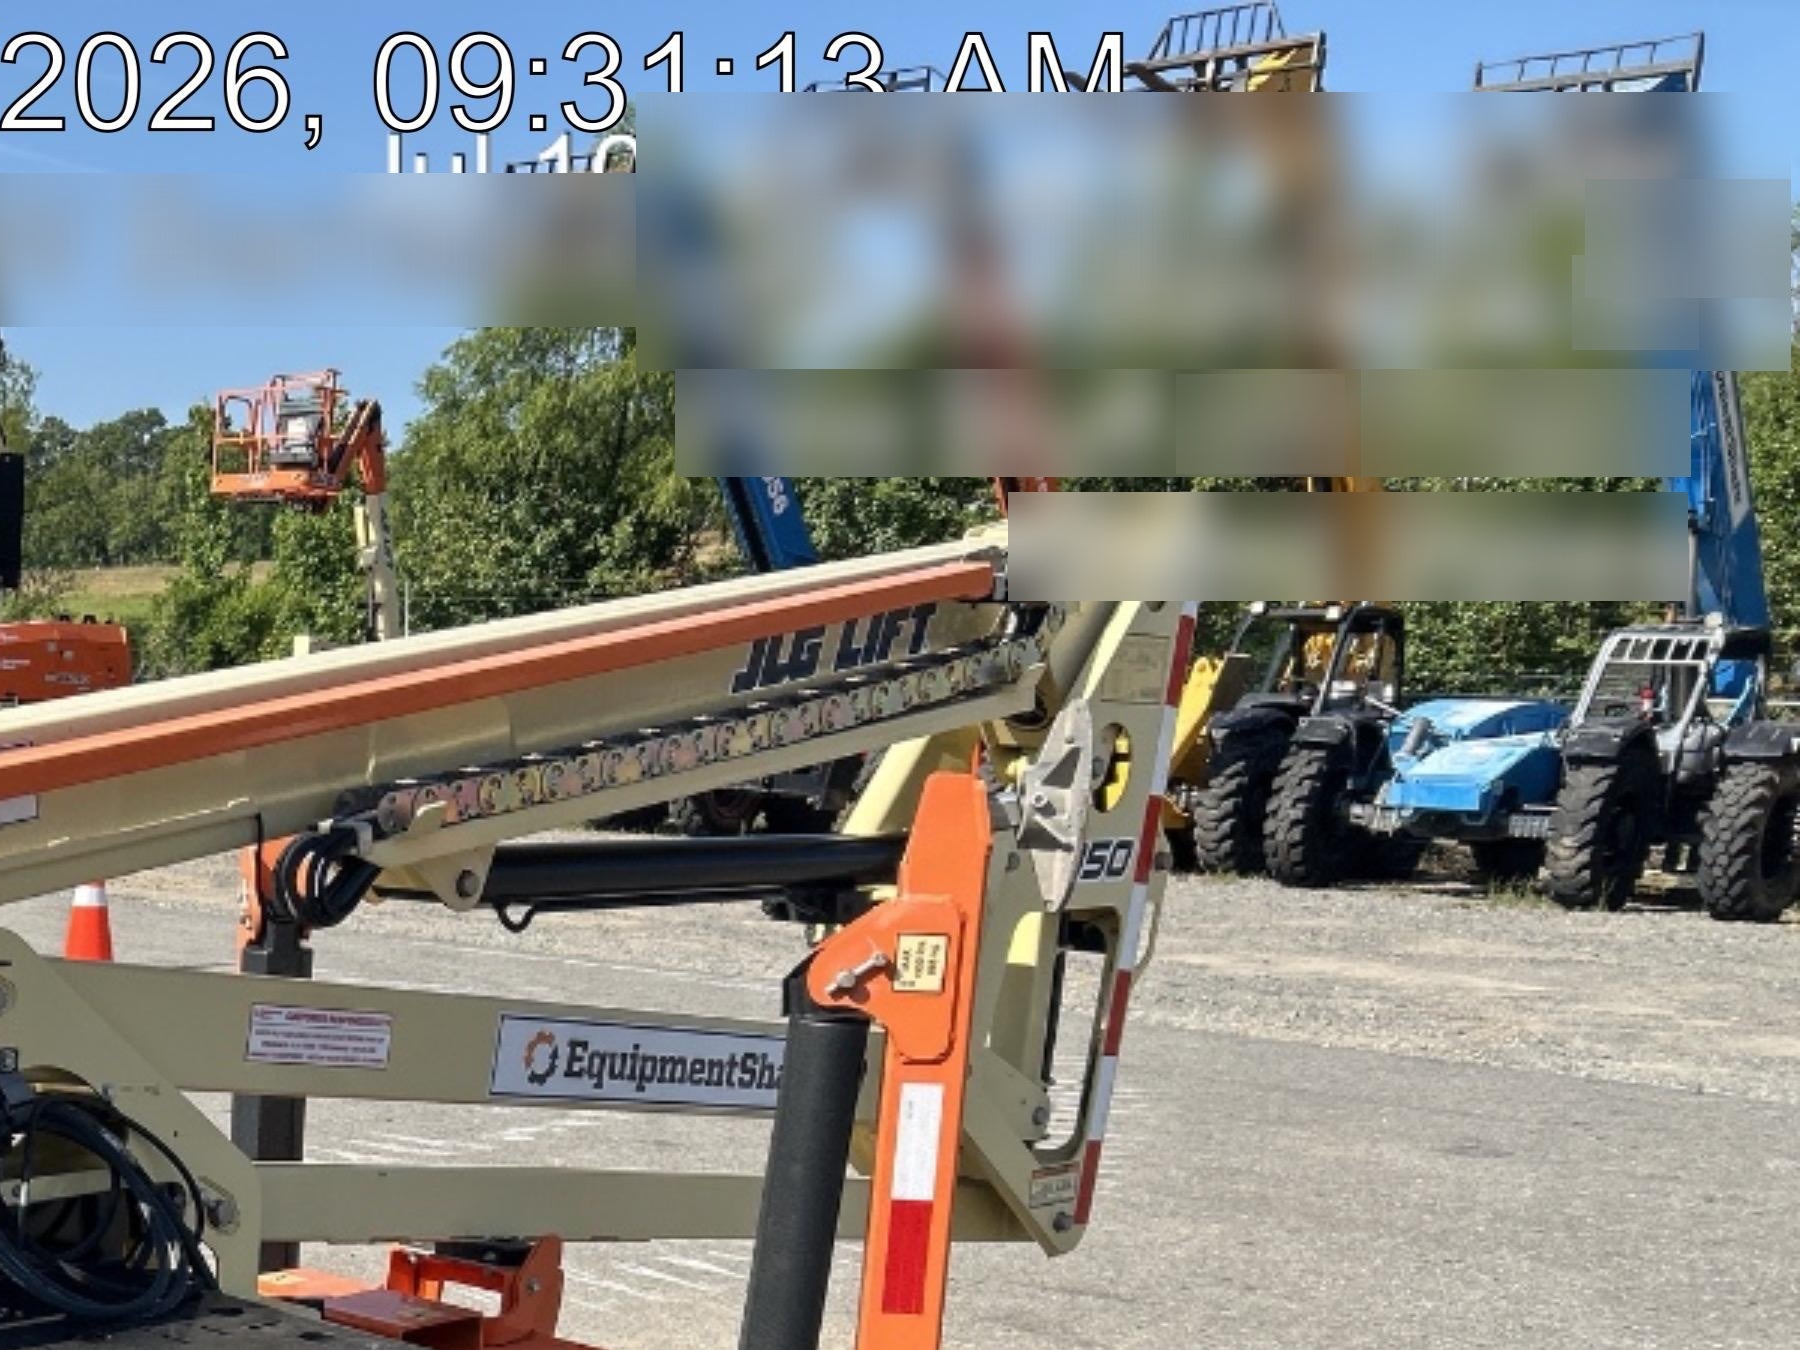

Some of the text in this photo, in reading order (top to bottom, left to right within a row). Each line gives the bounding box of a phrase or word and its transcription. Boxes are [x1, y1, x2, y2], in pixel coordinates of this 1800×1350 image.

[731, 602, 937, 693] JLG LIFT
[1079, 839, 1135, 880] 50
